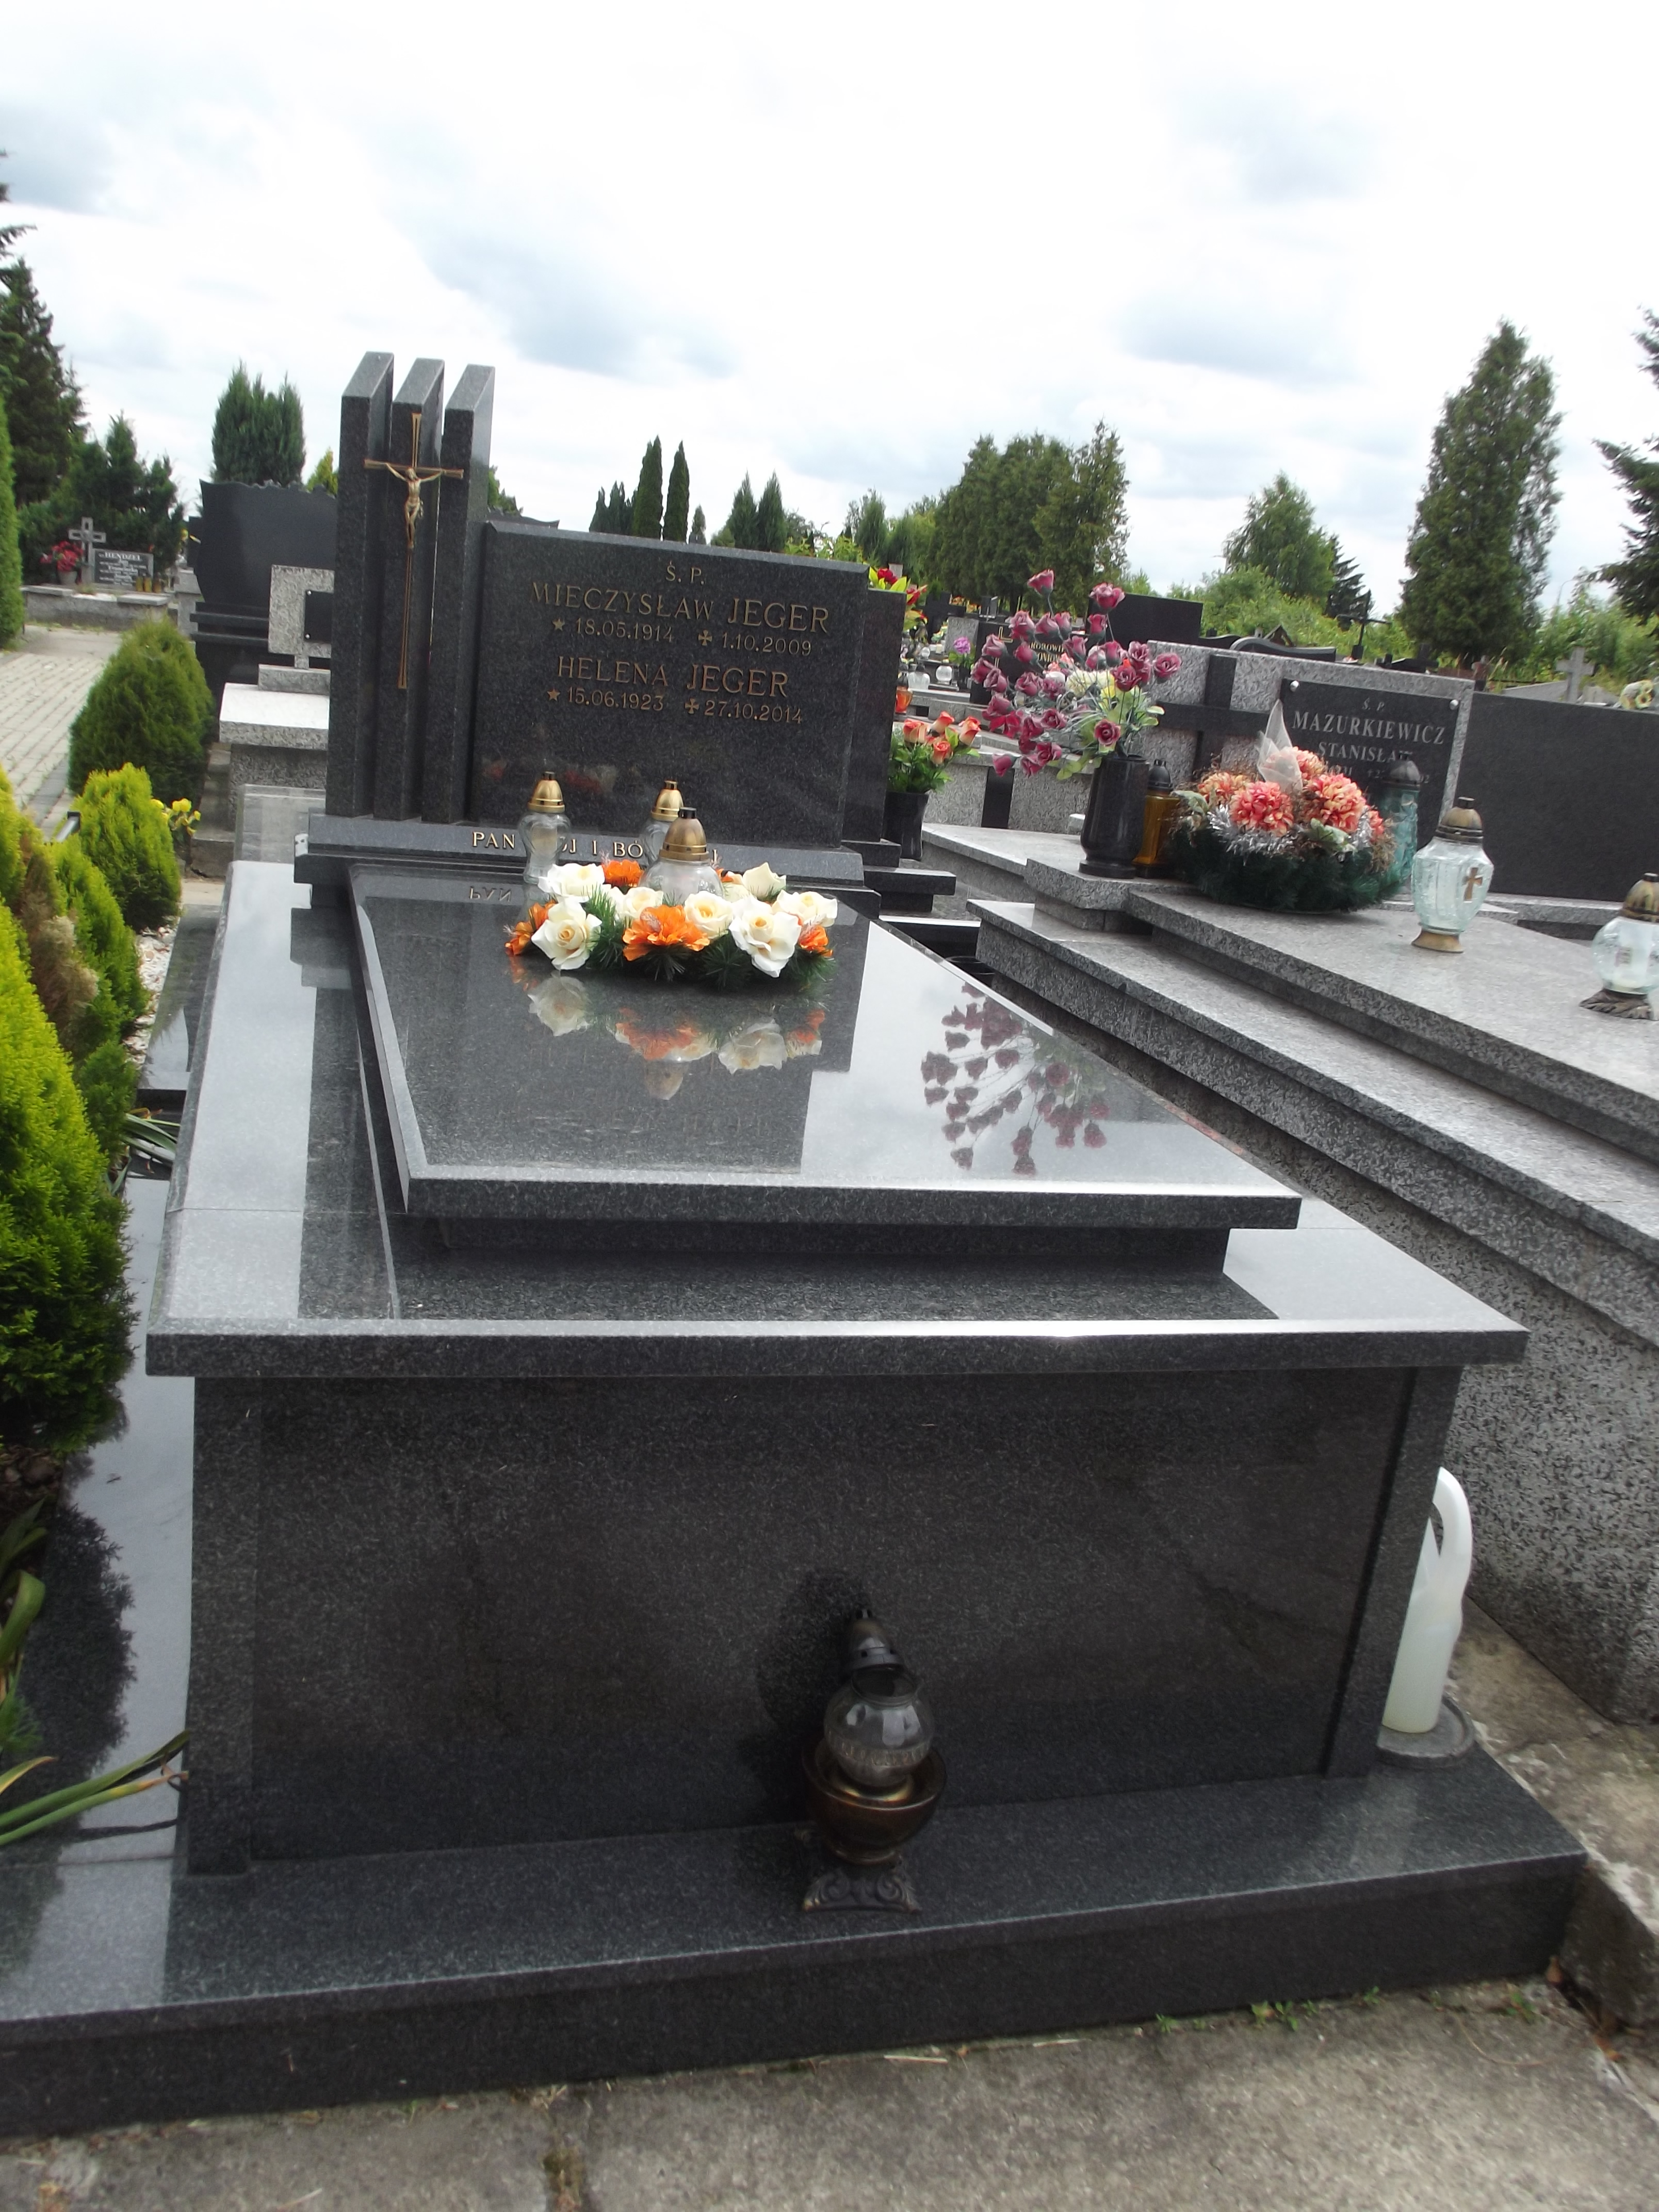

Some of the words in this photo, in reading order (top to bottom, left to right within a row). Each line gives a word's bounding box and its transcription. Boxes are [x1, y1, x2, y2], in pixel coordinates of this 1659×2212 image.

[665, 560, 681, 583] Ś.
[691, 567, 705, 585] P.
[530, 581, 714, 621] MIECZYSŁAW
[727, 598, 829, 633] JEGER
[576, 617, 673, 642] 18.05.1914
[723, 632, 811, 656] 1.10.2009
[558, 656, 669, 686] HELENA
[686, 664, 788, 697] JEGER
[567, 686, 663, 711] 15.06.1923
[704, 700, 802, 723] 27.10.2014
[1291, 710, 1446, 745] MAZURKIEWICZ
[472, 831, 515, 850] PAN
[592, 840, 598, 855] I
[613, 839, 644, 858] BÓ
